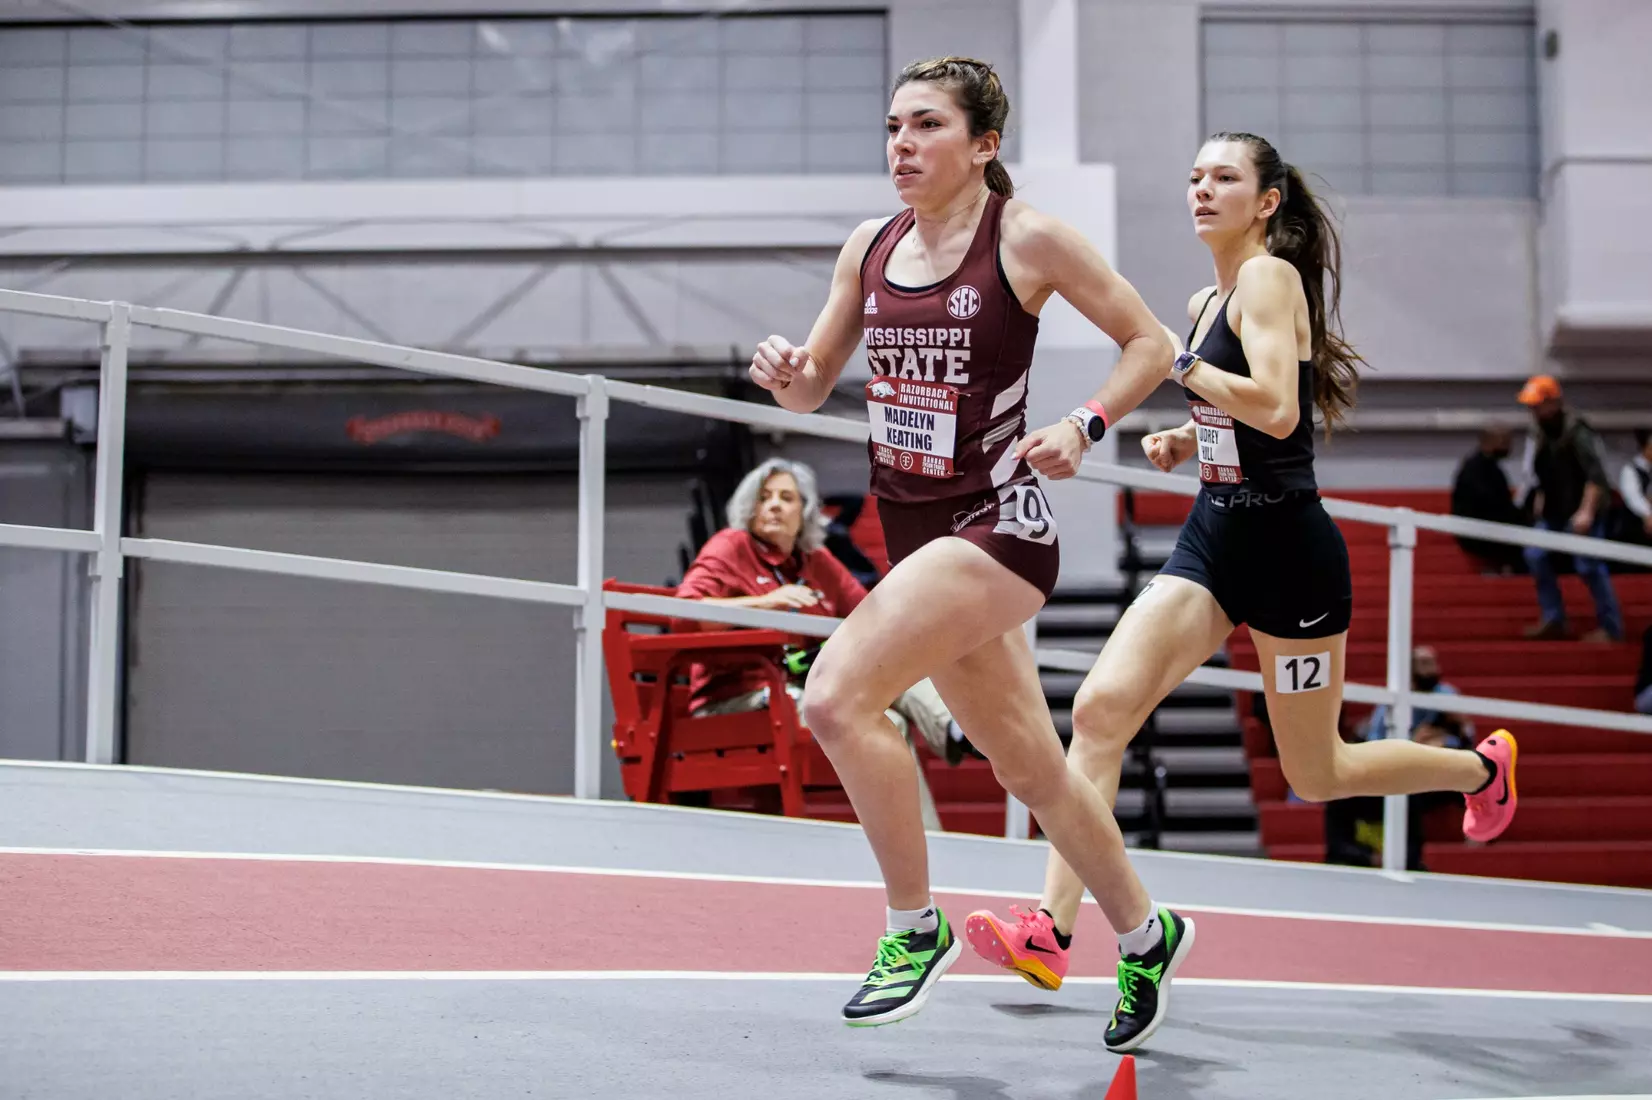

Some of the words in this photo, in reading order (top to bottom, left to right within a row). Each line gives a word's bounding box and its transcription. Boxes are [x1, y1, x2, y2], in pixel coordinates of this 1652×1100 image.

[949, 287, 978, 317] SEC
[864, 327, 971, 347] MISSISSIPPI
[868, 348, 971, 384] STATE
[899, 393, 954, 411] INVITATIONAL
[900, 383, 948, 399] RAZORBACK
[884, 406, 935, 431] MADELYN
[886, 426, 932, 451] KEATING
[1198, 427, 1219, 444] UDREY
[922, 466, 945, 476] CENTER
[1285, 657, 1321, 691] 12
